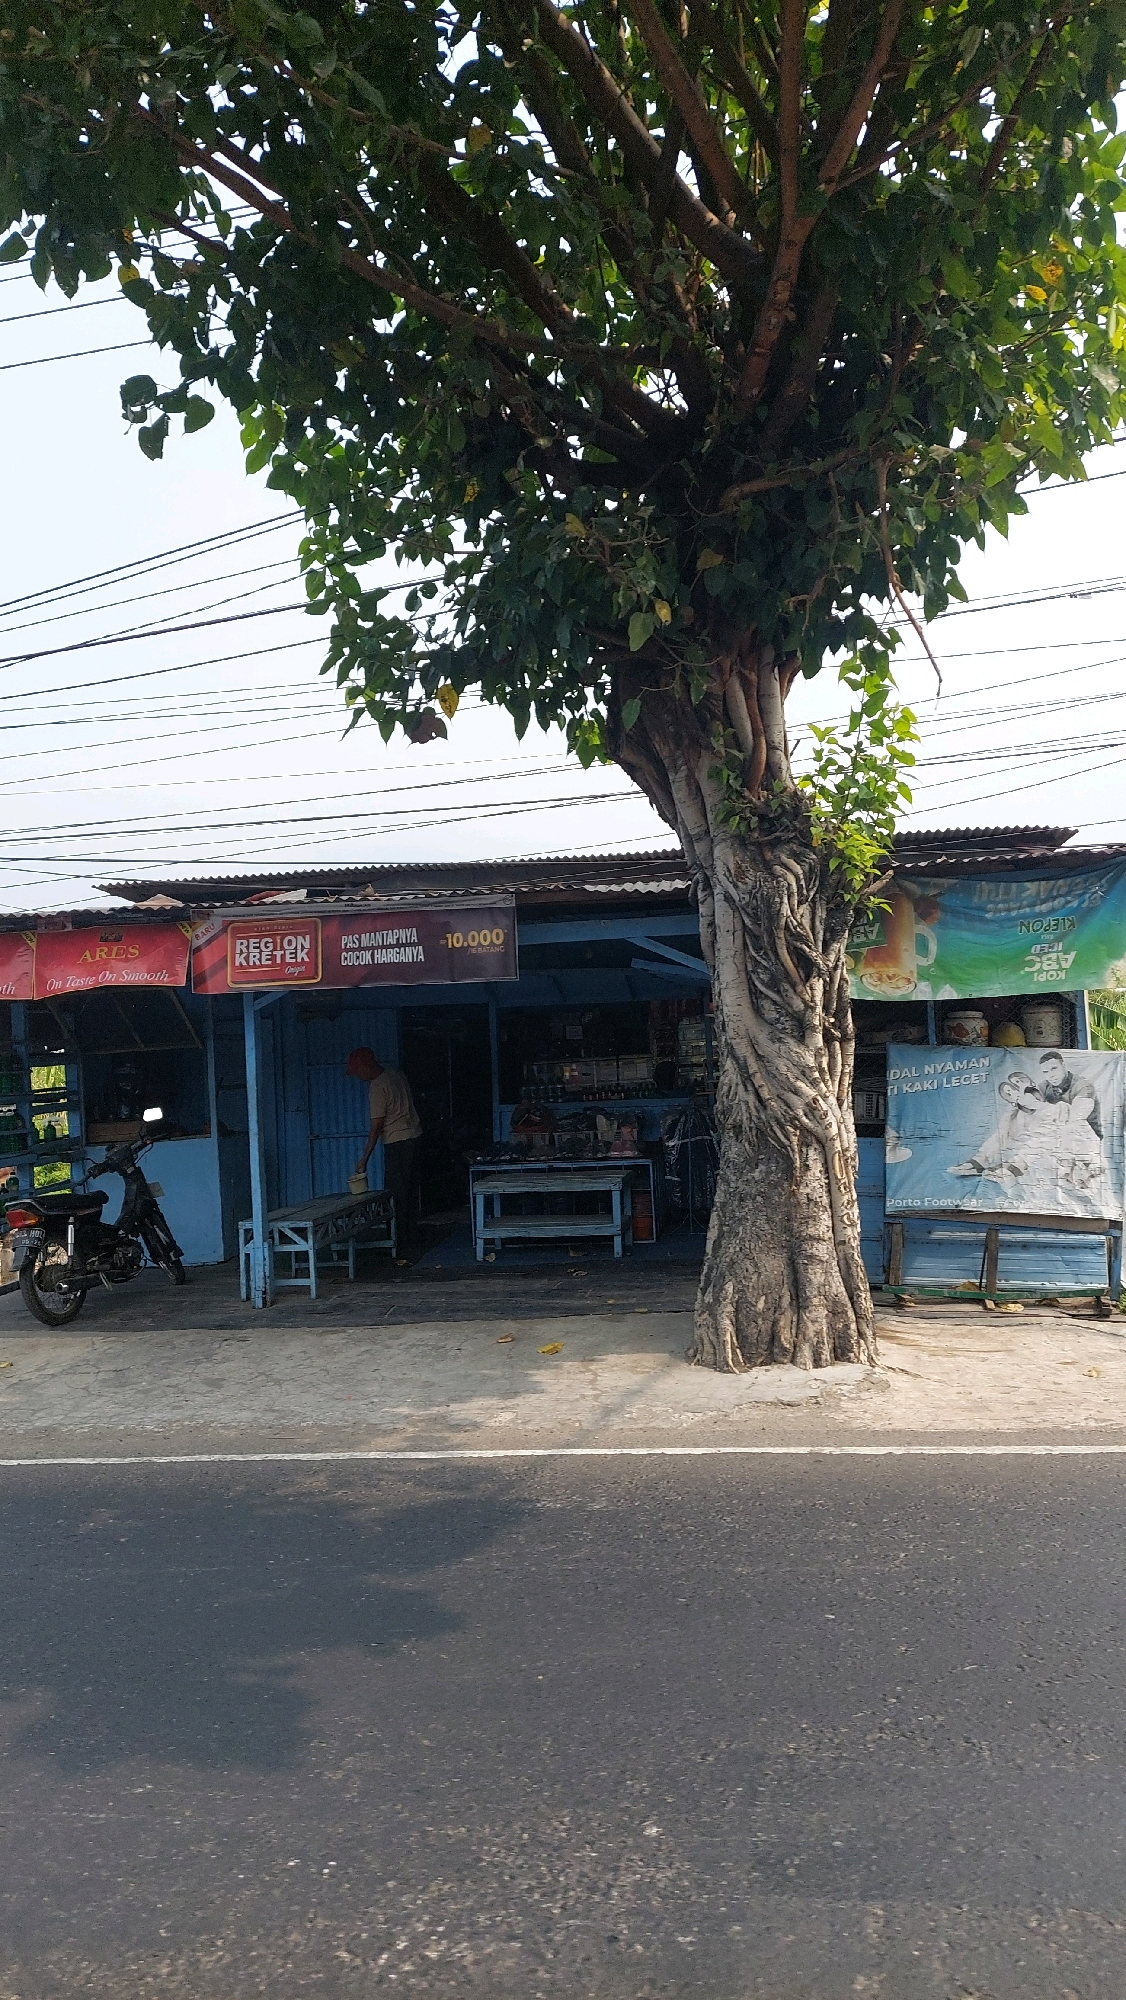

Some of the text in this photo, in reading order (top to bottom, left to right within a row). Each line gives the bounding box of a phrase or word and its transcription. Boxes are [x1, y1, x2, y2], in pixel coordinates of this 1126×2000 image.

[194, 922, 216, 941] BARU
[1018, 916, 1077, 934] KLEPON
[341, 927, 418, 949] PAS MANTAPNYA
[446, 928, 504, 948] 10.000
[77, 944, 140, 964] ARES
[235, 948, 310, 967] KRETEK
[341, 946, 425, 966] COCOK HARGANYA
[478, 945, 505, 954] BATANG
[1031, 942, 1063, 954] ICED
[1024, 950, 1077, 972] ABC
[46, 969, 169, 992] On Taste On Smooth
[1033, 970, 1066, 982] KOPI
[0, 982, 15, 995] th
[924, 1057, 991, 1075] NYAMAN
[902, 1080, 938, 1094] KAKI
[942, 1072, 989, 1088] LECET
[886, 1198, 920, 1207] Porto
[924, 1198, 984, 1207] Footwear
